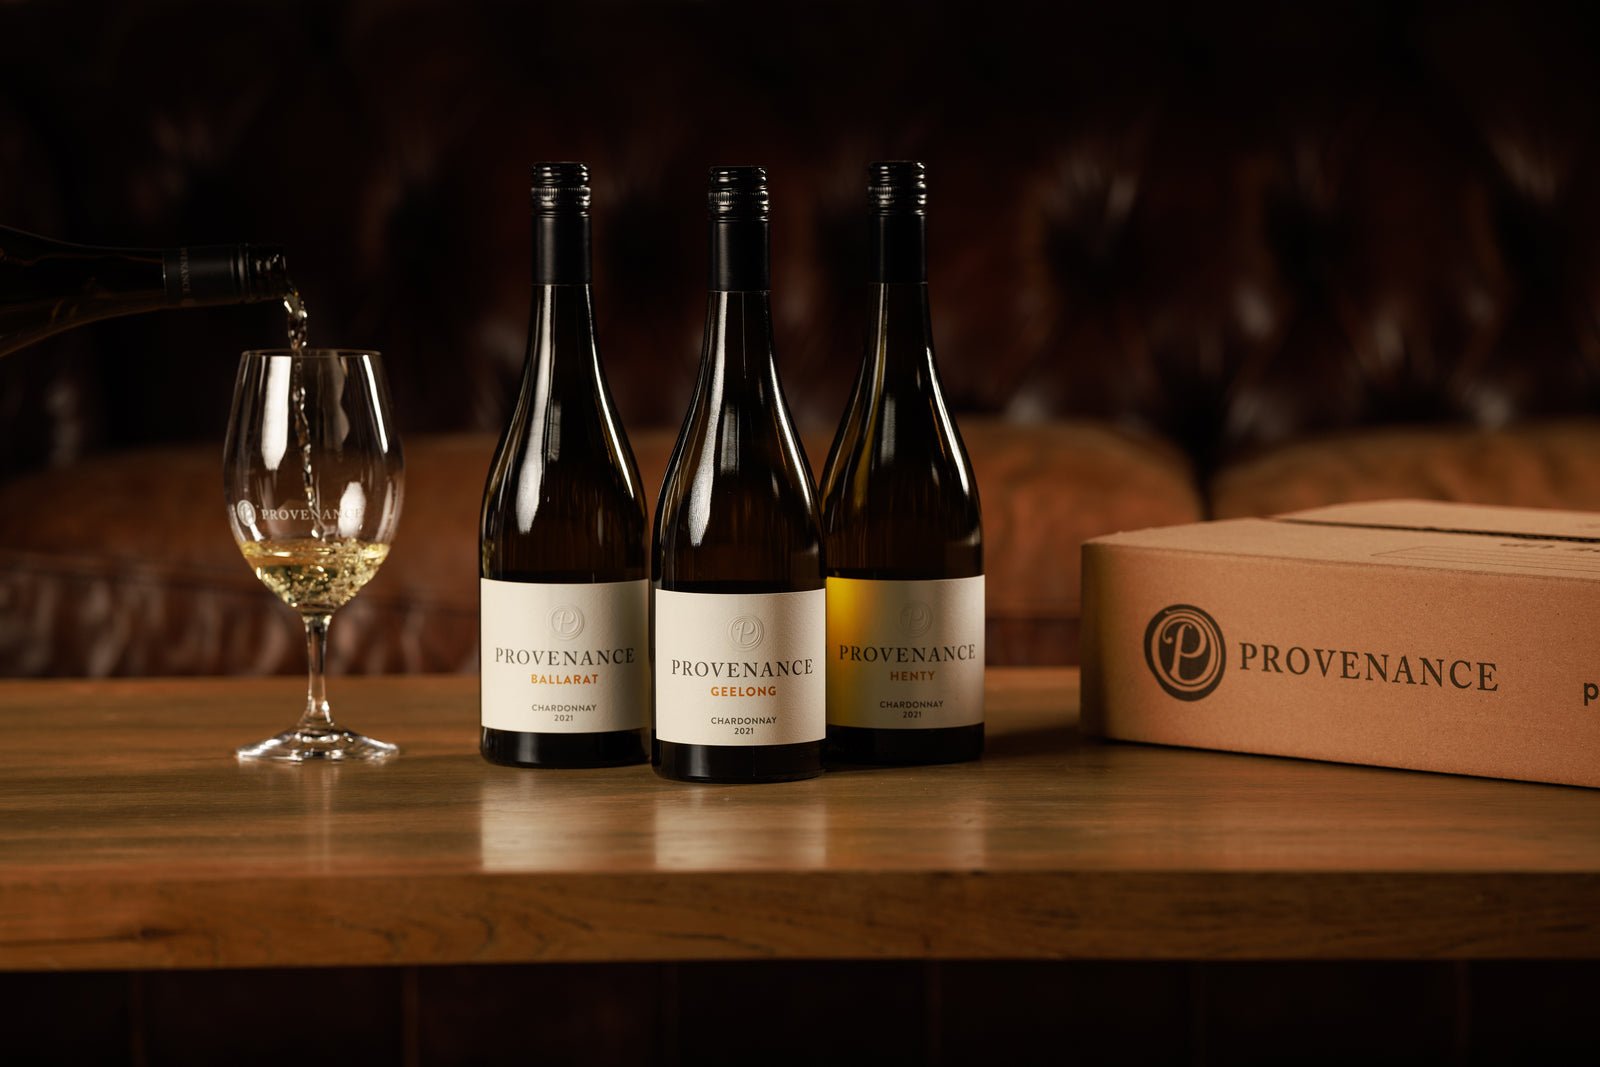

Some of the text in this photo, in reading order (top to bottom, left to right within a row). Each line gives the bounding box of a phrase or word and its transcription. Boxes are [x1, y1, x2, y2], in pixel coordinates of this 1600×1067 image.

[495, 647, 635, 666] PROVENANCE
[839, 644, 976, 663] PROVENANCE
[671, 658, 813, 678] PROVENANCE
[1239, 641, 1499, 692] PROVENANCE
[531, 674, 599, 685] BALLARAT
[890, 671, 936, 681] HENTY
[710, 686, 777, 697] GEELONG
[531, 703, 598, 712] CHARDONNAY
[880, 700, 944, 709] CHARDONNAY
[554, 714, 574, 722] 2021
[903, 711, 922, 719] 2021
[710, 716, 777, 725] CHARDONNAY
[734, 727, 754, 735] 2021
